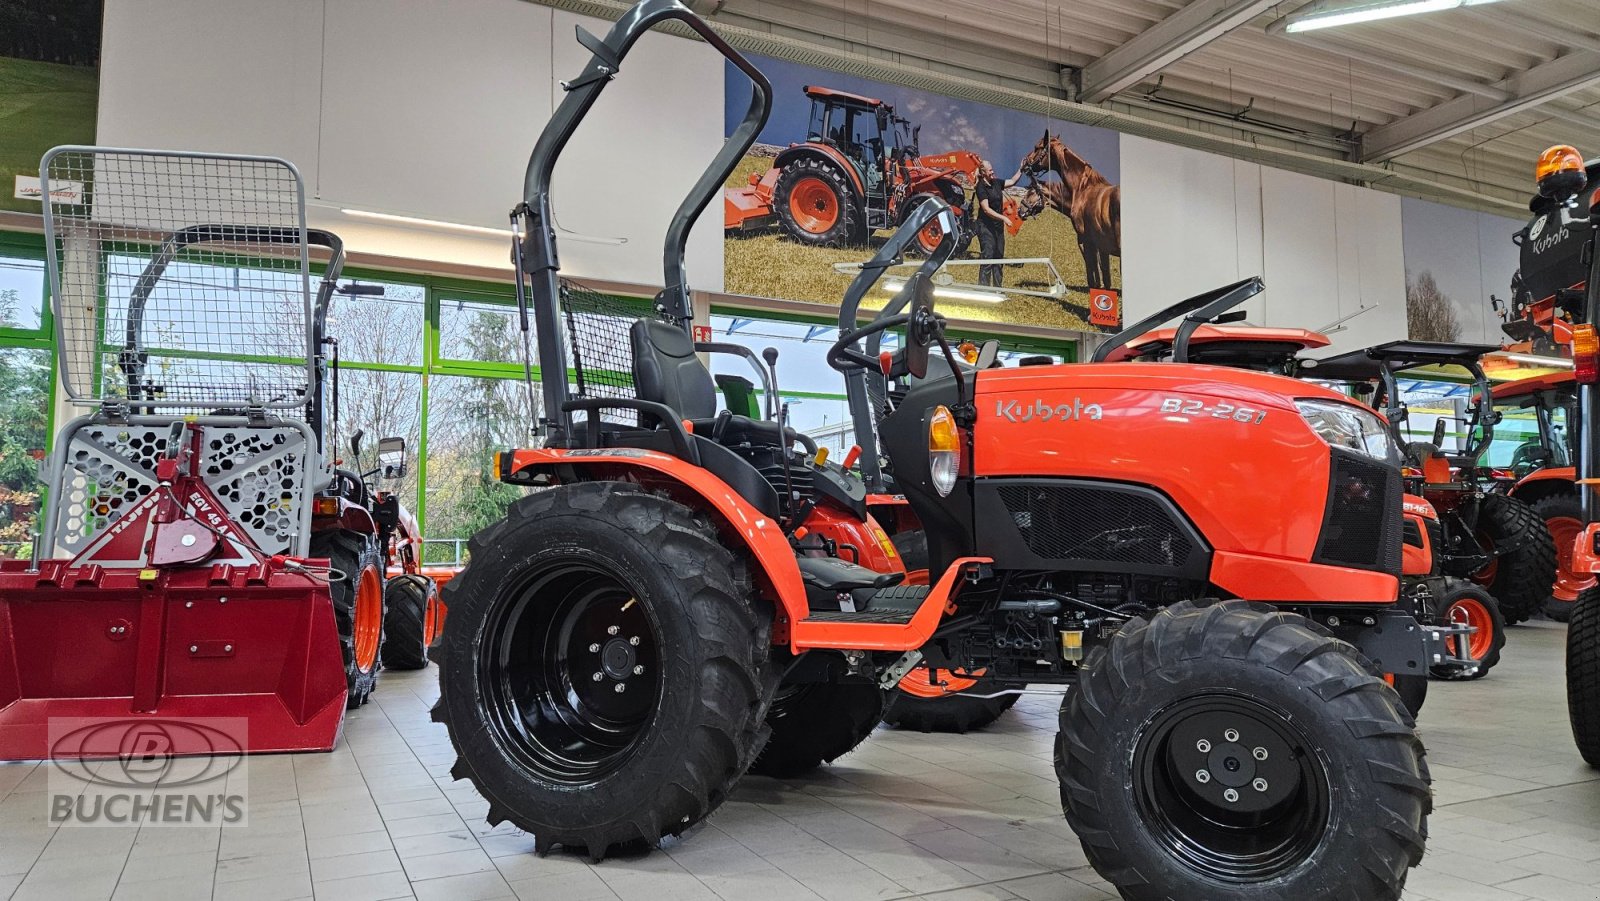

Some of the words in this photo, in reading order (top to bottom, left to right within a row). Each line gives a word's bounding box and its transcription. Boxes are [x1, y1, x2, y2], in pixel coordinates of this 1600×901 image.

[1533, 226, 1569, 254] Kubota
[1092, 312, 1116, 321] Kubota
[996, 397, 1103, 422] Kubota
[1160, 398, 1267, 425] B2-261
[209, 434, 260, 462] TAJFUN
[111, 492, 160, 534] TAJFUN
[189, 492, 212, 512] EGV
[207, 512, 222, 526] 45
[217, 524, 228, 535] A
